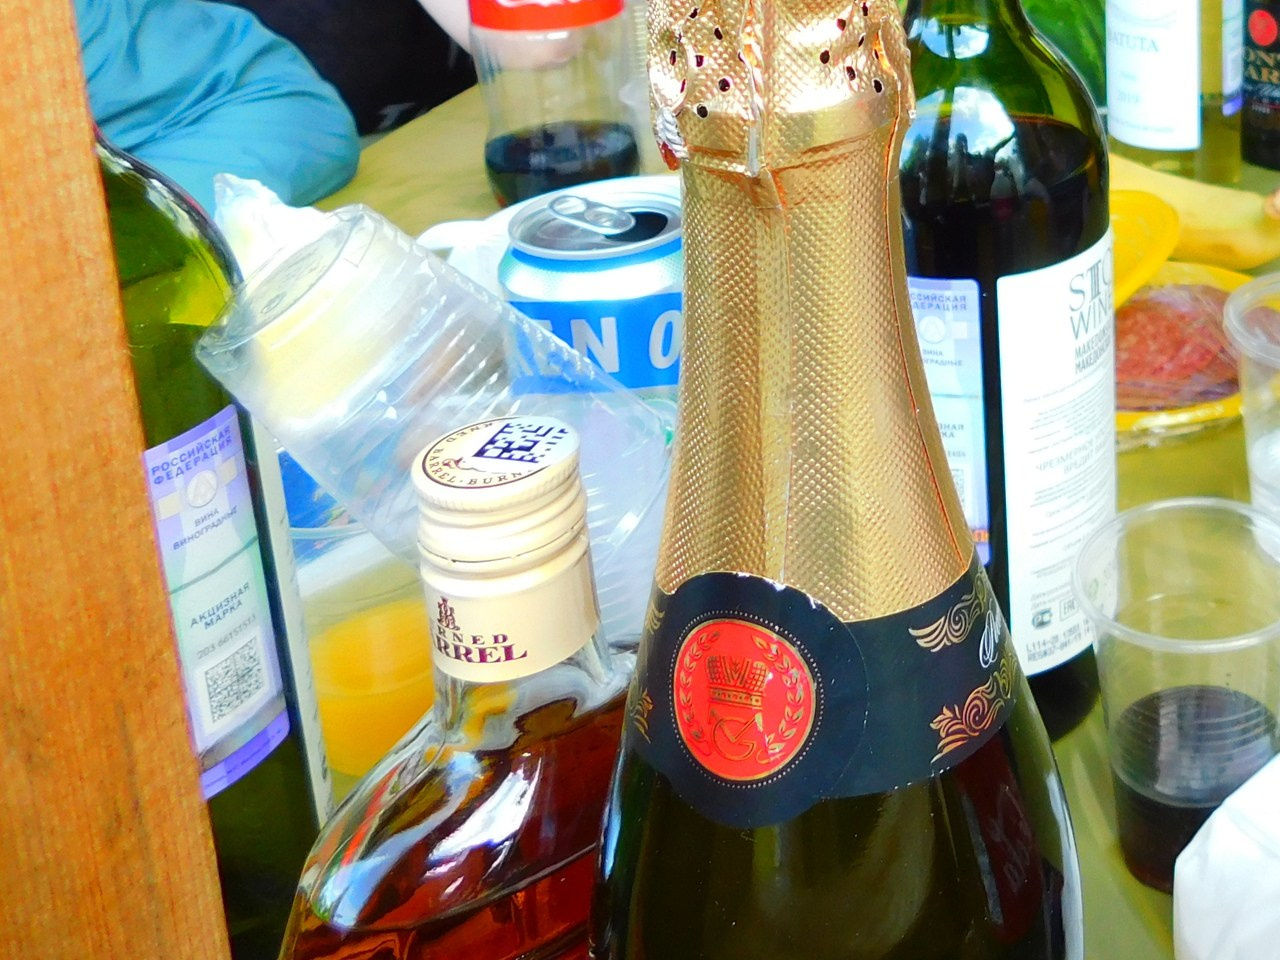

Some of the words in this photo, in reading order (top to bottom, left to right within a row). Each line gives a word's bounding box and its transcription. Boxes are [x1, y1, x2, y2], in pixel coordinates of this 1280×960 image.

[151, 424, 231, 476] РОССИЙСКАЯ
[153, 435, 232, 485] ФЕДЕРАЦИЯ
[173, 505, 238, 550] ВИНОГРАДНЫЕ
[194, 507, 219, 528] ВИНА
[190, 581, 250, 628] АКЦИЗНАЯ
[204, 600, 243, 630] МАРКА
[435, 633, 528, 664] RREL
